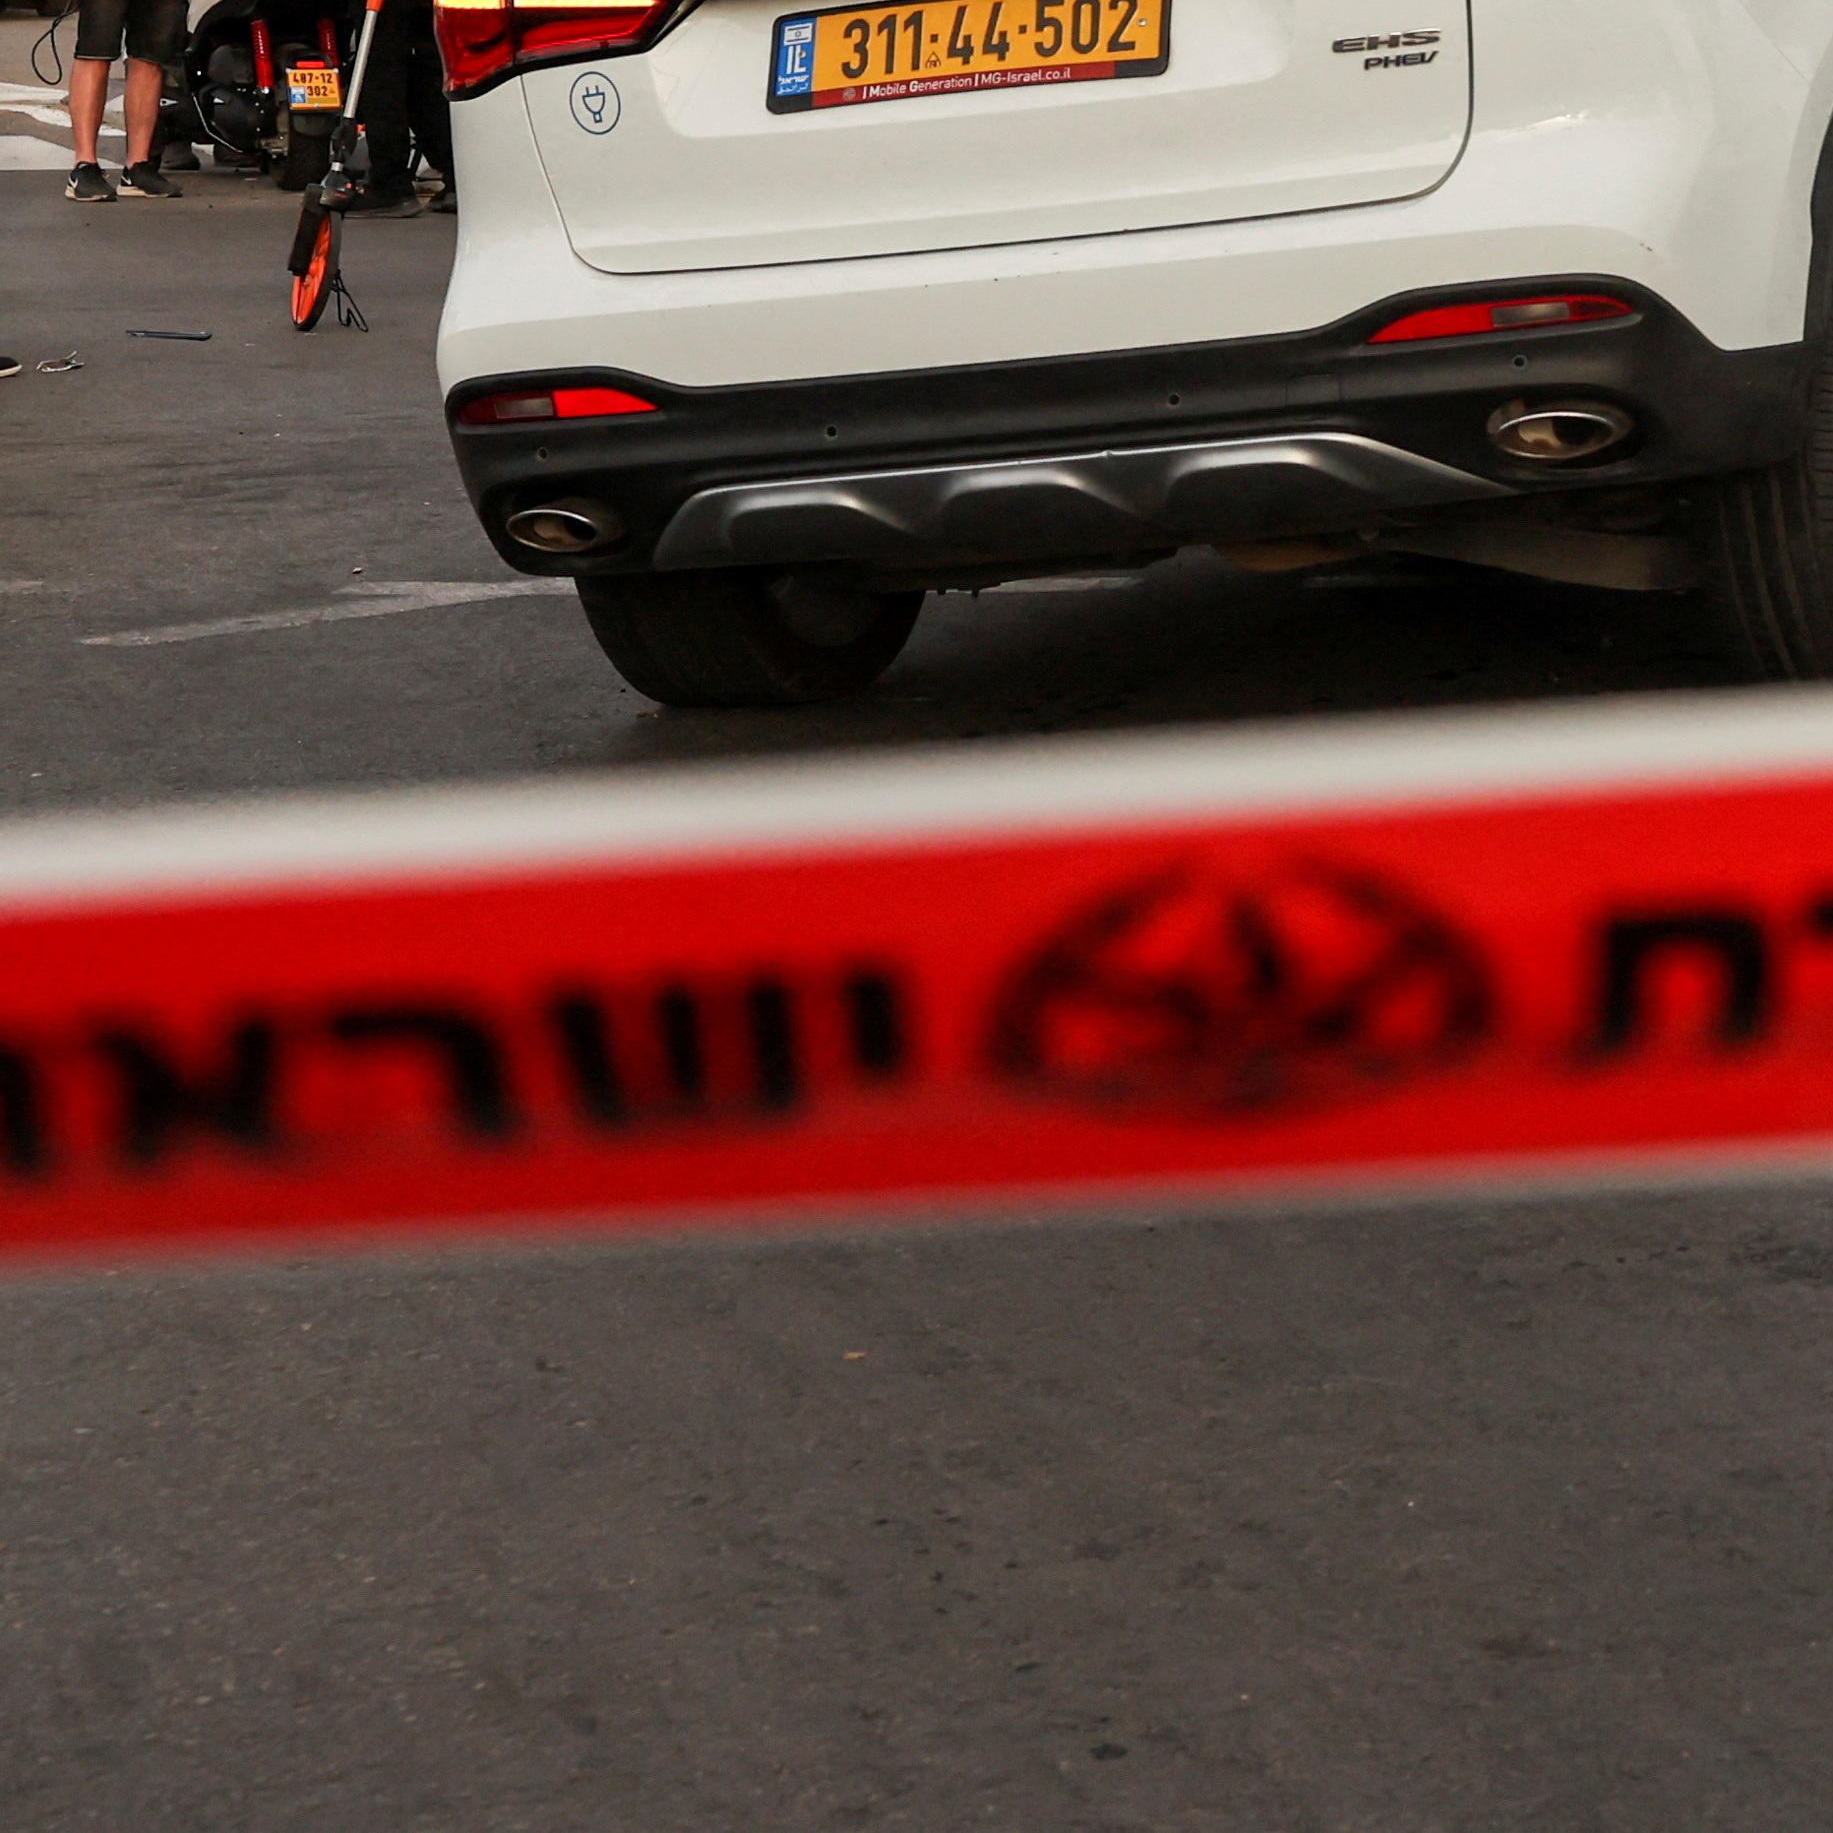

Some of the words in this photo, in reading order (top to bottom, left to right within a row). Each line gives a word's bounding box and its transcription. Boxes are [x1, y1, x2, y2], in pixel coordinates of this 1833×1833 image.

[1331, 28, 1442, 53] EHS
[1364, 50, 1440, 71] PHEV
[306, 85, 328, 97] 302
[868, 81, 907, 100] Mobile
[908, 75, 973, 93] Generation
[980, 67, 1072, 87] MG-Israel.co.il
